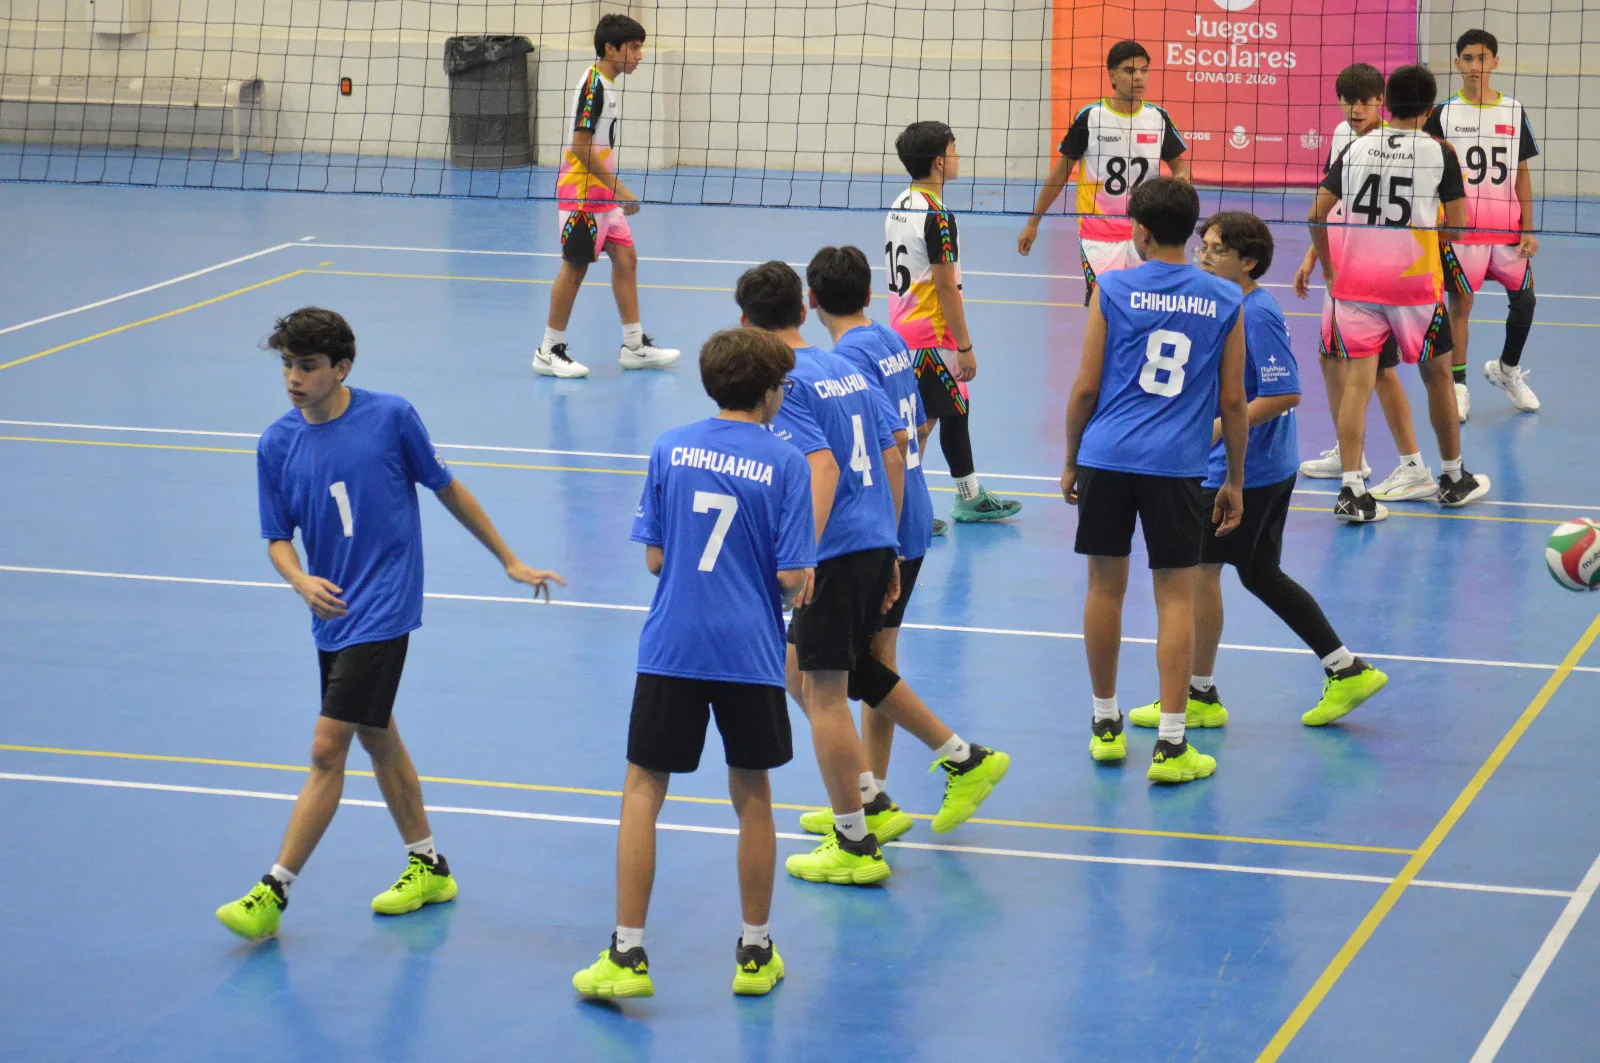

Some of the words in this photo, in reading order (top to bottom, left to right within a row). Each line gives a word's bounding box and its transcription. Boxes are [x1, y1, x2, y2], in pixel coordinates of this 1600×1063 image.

[1186, 14, 1278, 46] Juegos
[1166, 43, 1297, 69] Escolares
[1186, 71, 1242, 84] CONADE
[1245, 73, 1277, 85] 2026
[1104, 156, 1149, 196] 82
[1465, 145, 1508, 186] 95
[1351, 173, 1414, 226] 45
[885, 240, 912, 298] 16
[1130, 291, 1217, 318] CHIHUAHUA
[1138, 328, 1192, 398] 8
[671, 446, 773, 487] CHIHUAHUA
[850, 413, 874, 487] 4
[329, 481, 354, 537] 1
[692, 490, 739, 572] 7
